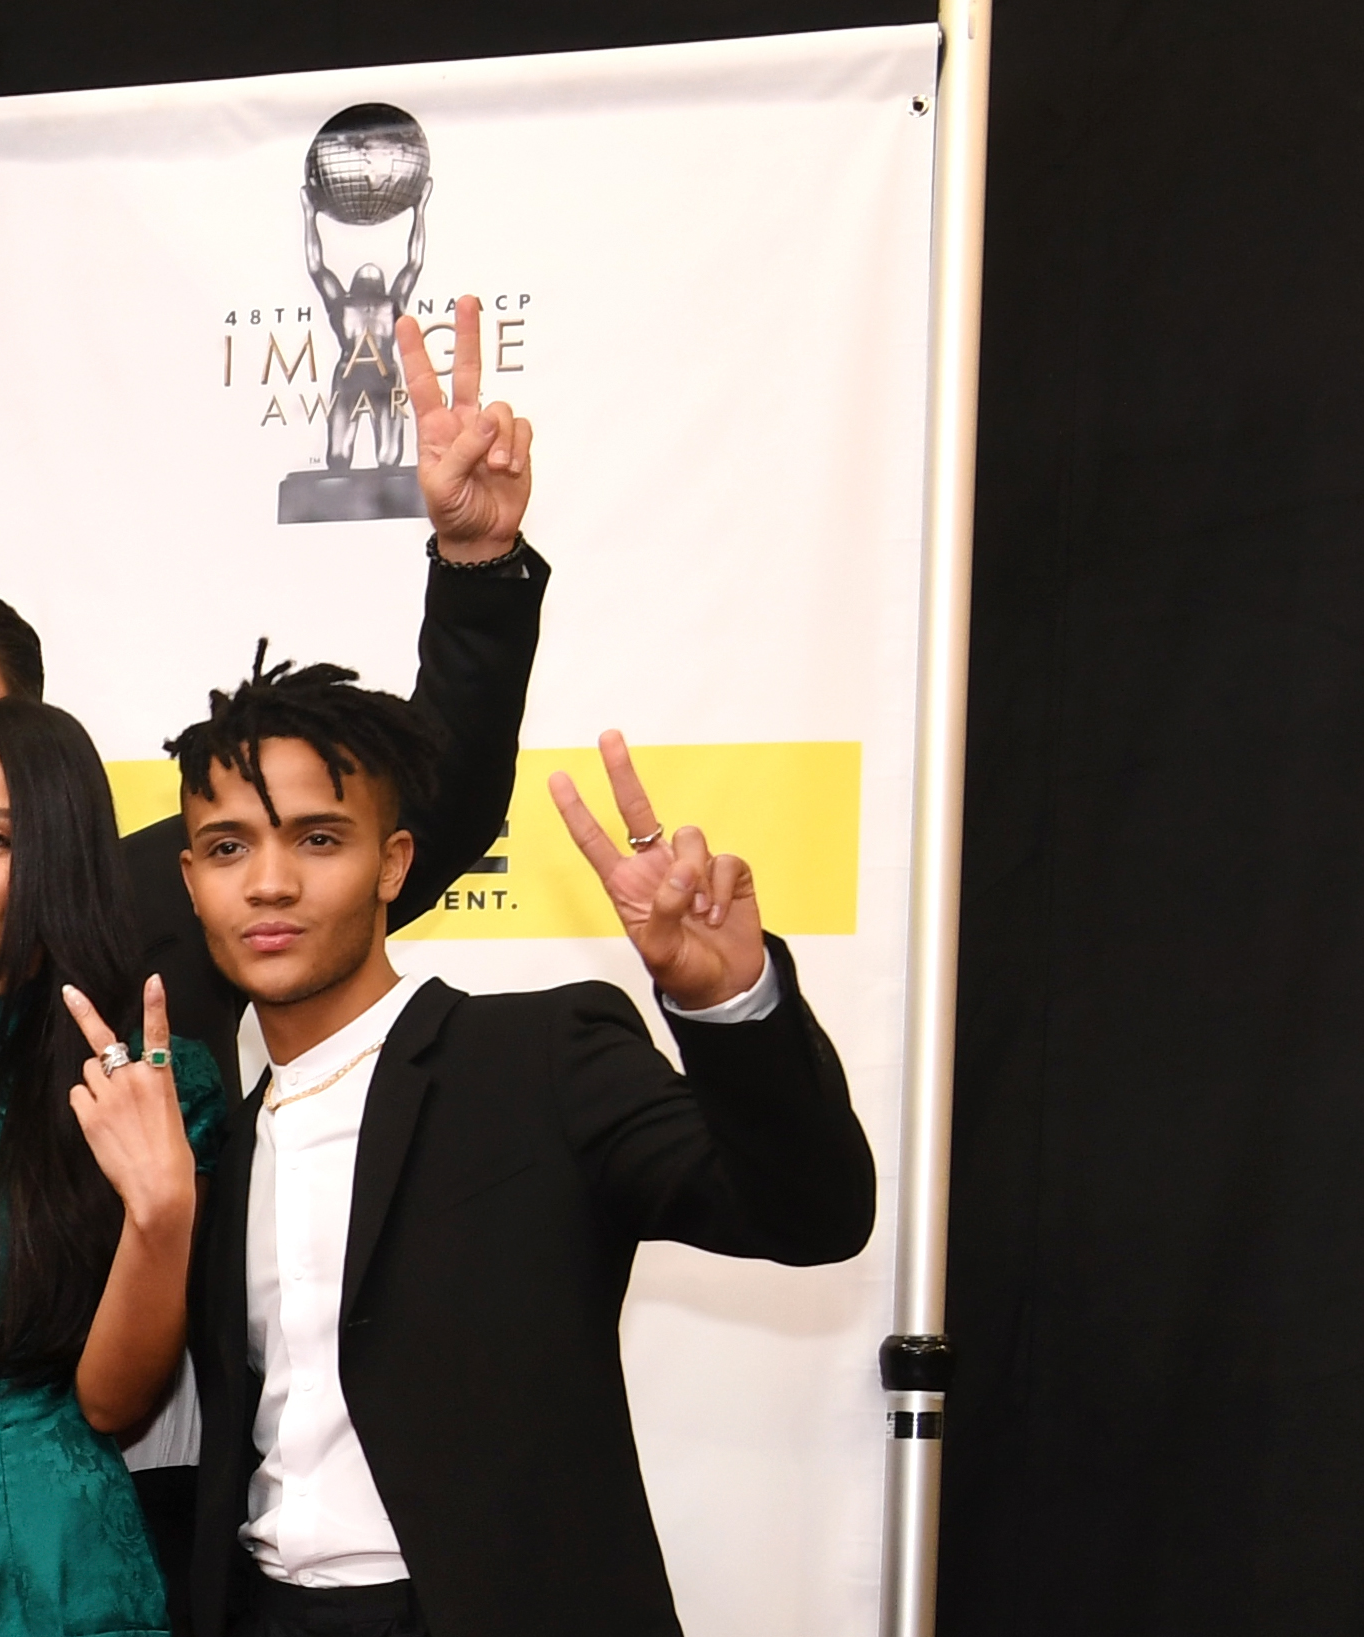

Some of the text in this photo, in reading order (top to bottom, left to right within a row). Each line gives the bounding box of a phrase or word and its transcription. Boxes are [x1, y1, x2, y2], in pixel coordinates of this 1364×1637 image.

[224, 306, 312, 326] 48TH
[260, 388, 484, 428] AWAR
[444, 890, 518, 910] ENT.
